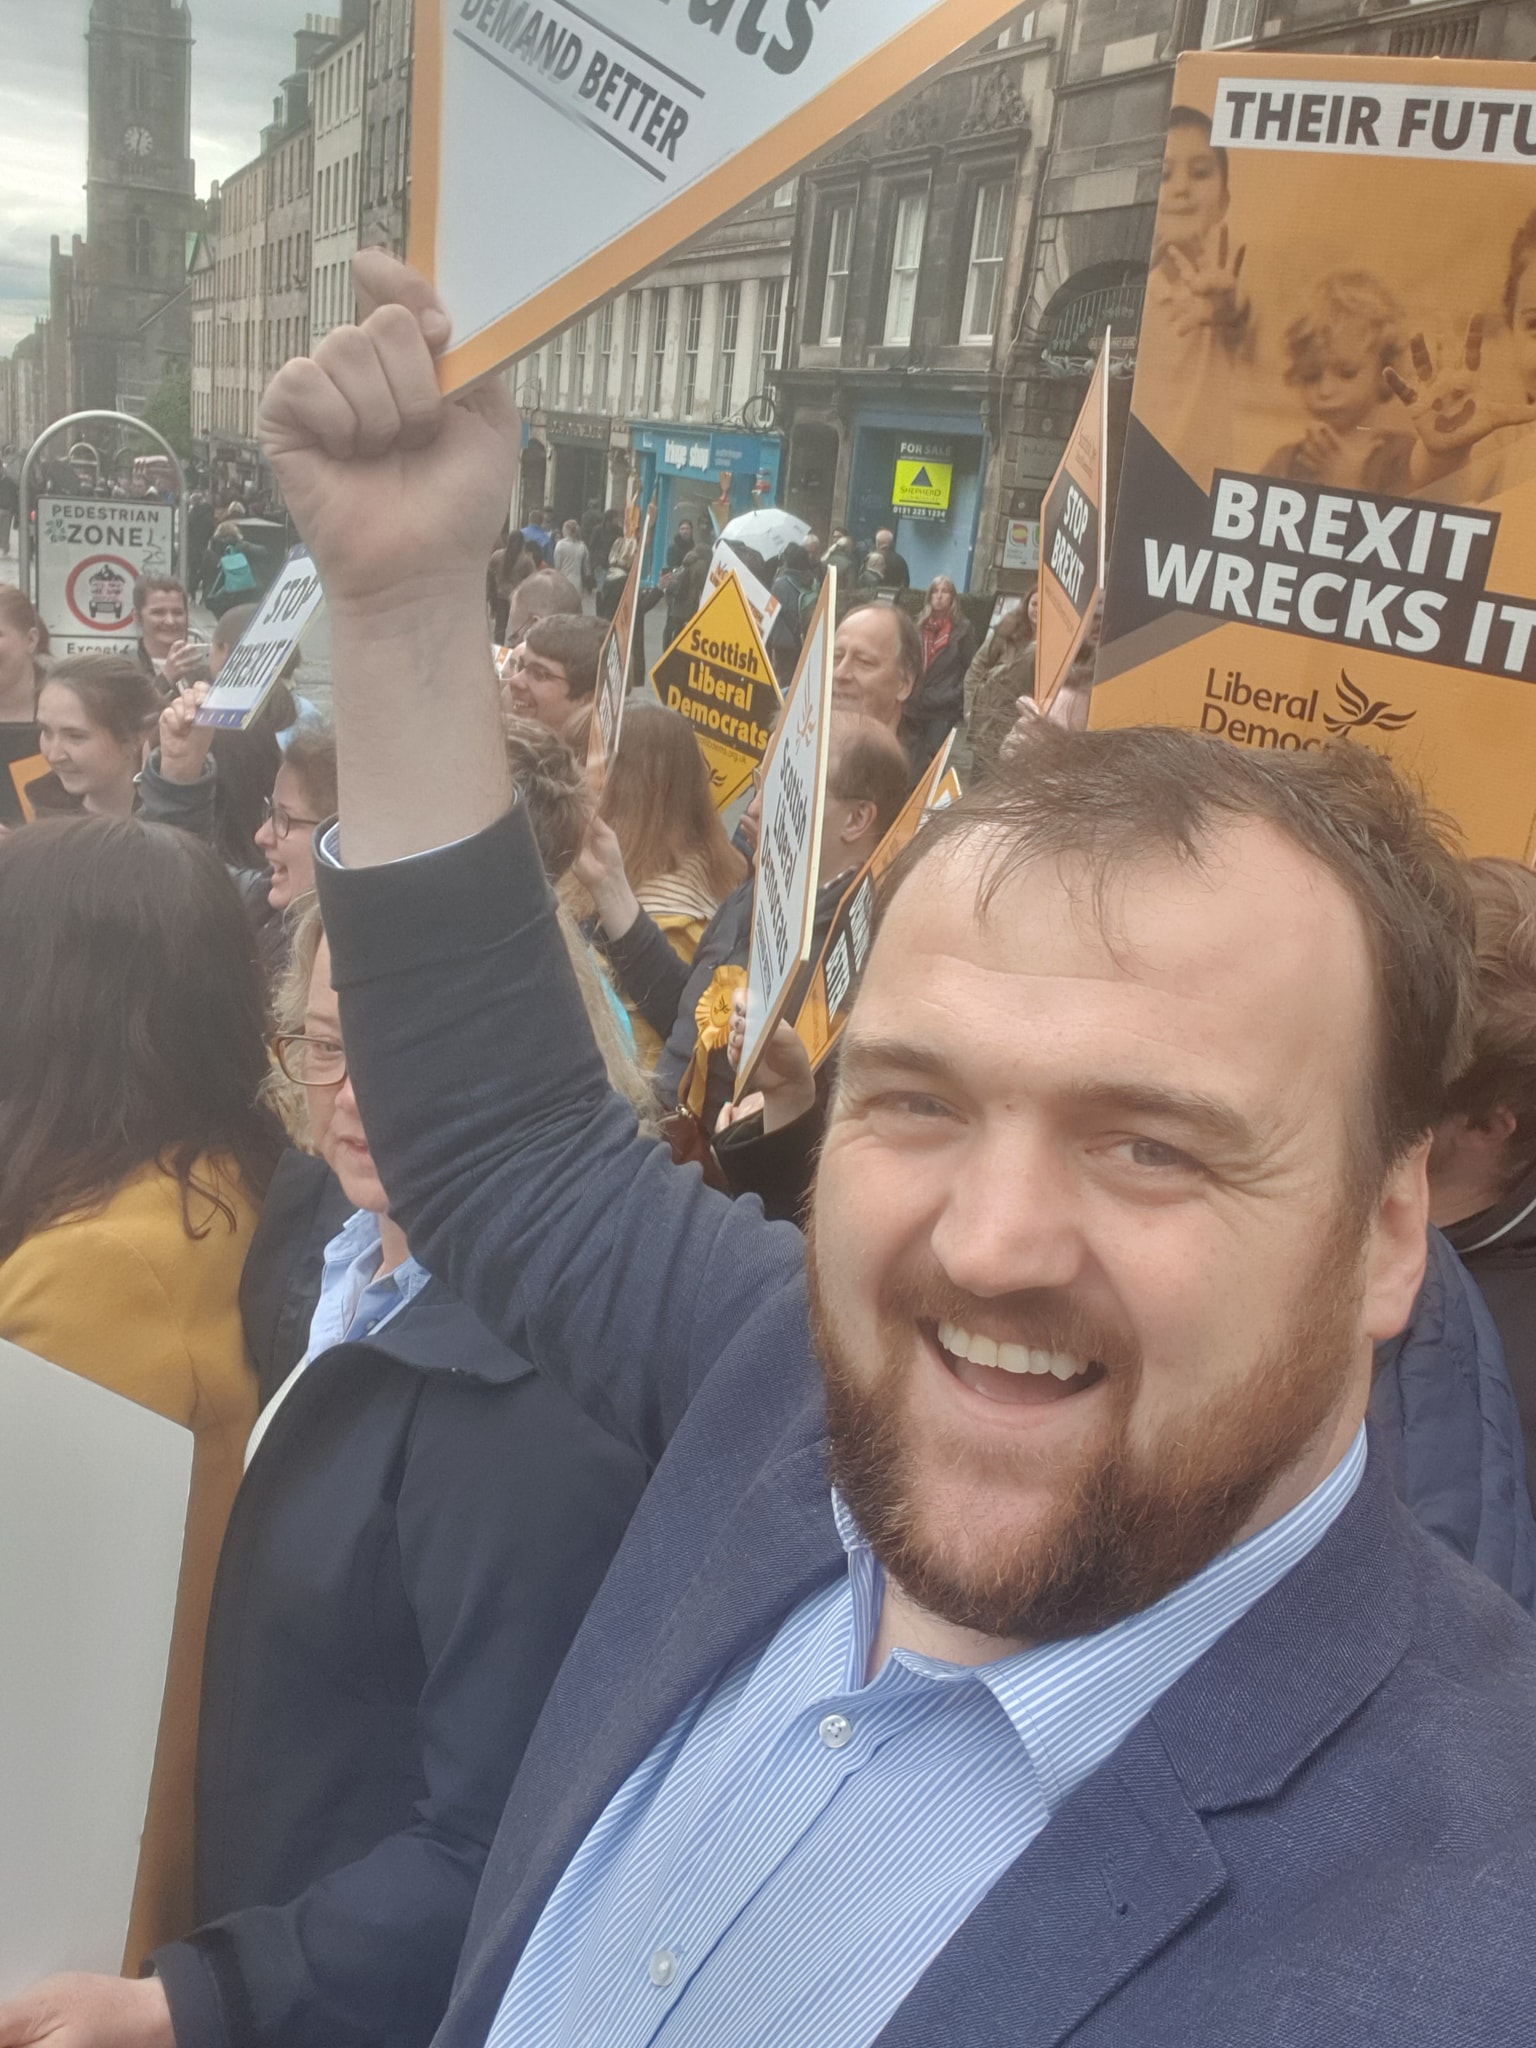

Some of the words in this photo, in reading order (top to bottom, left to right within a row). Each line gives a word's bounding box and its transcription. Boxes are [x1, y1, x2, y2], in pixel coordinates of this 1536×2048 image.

[577, 50, 689, 162] BETTER
[1226, 91, 1382, 147] THEIR
[900, 442, 922, 455] FOR
[52, 504, 159, 523] PEDESTRIAN
[67, 524, 143, 547] ZONE
[1063, 484, 1089, 545] STOP
[1211, 478, 1492, 582] BREXIT
[1050, 528, 1085, 605] BREXIT
[1144, 538, 1449, 653] WRECKS
[263, 575, 319, 625] STOP
[215, 639, 289, 689] BREXIT
[690, 629, 758, 675] Scottish
[688, 661, 753, 711] Liberal
[1205, 667, 1319, 723] Liberal
[667, 685, 769, 751] Democrats
[779, 737, 808, 851] Scottish
[773, 792, 798, 900] Liberal
[760, 824, 789, 977] Democrats
